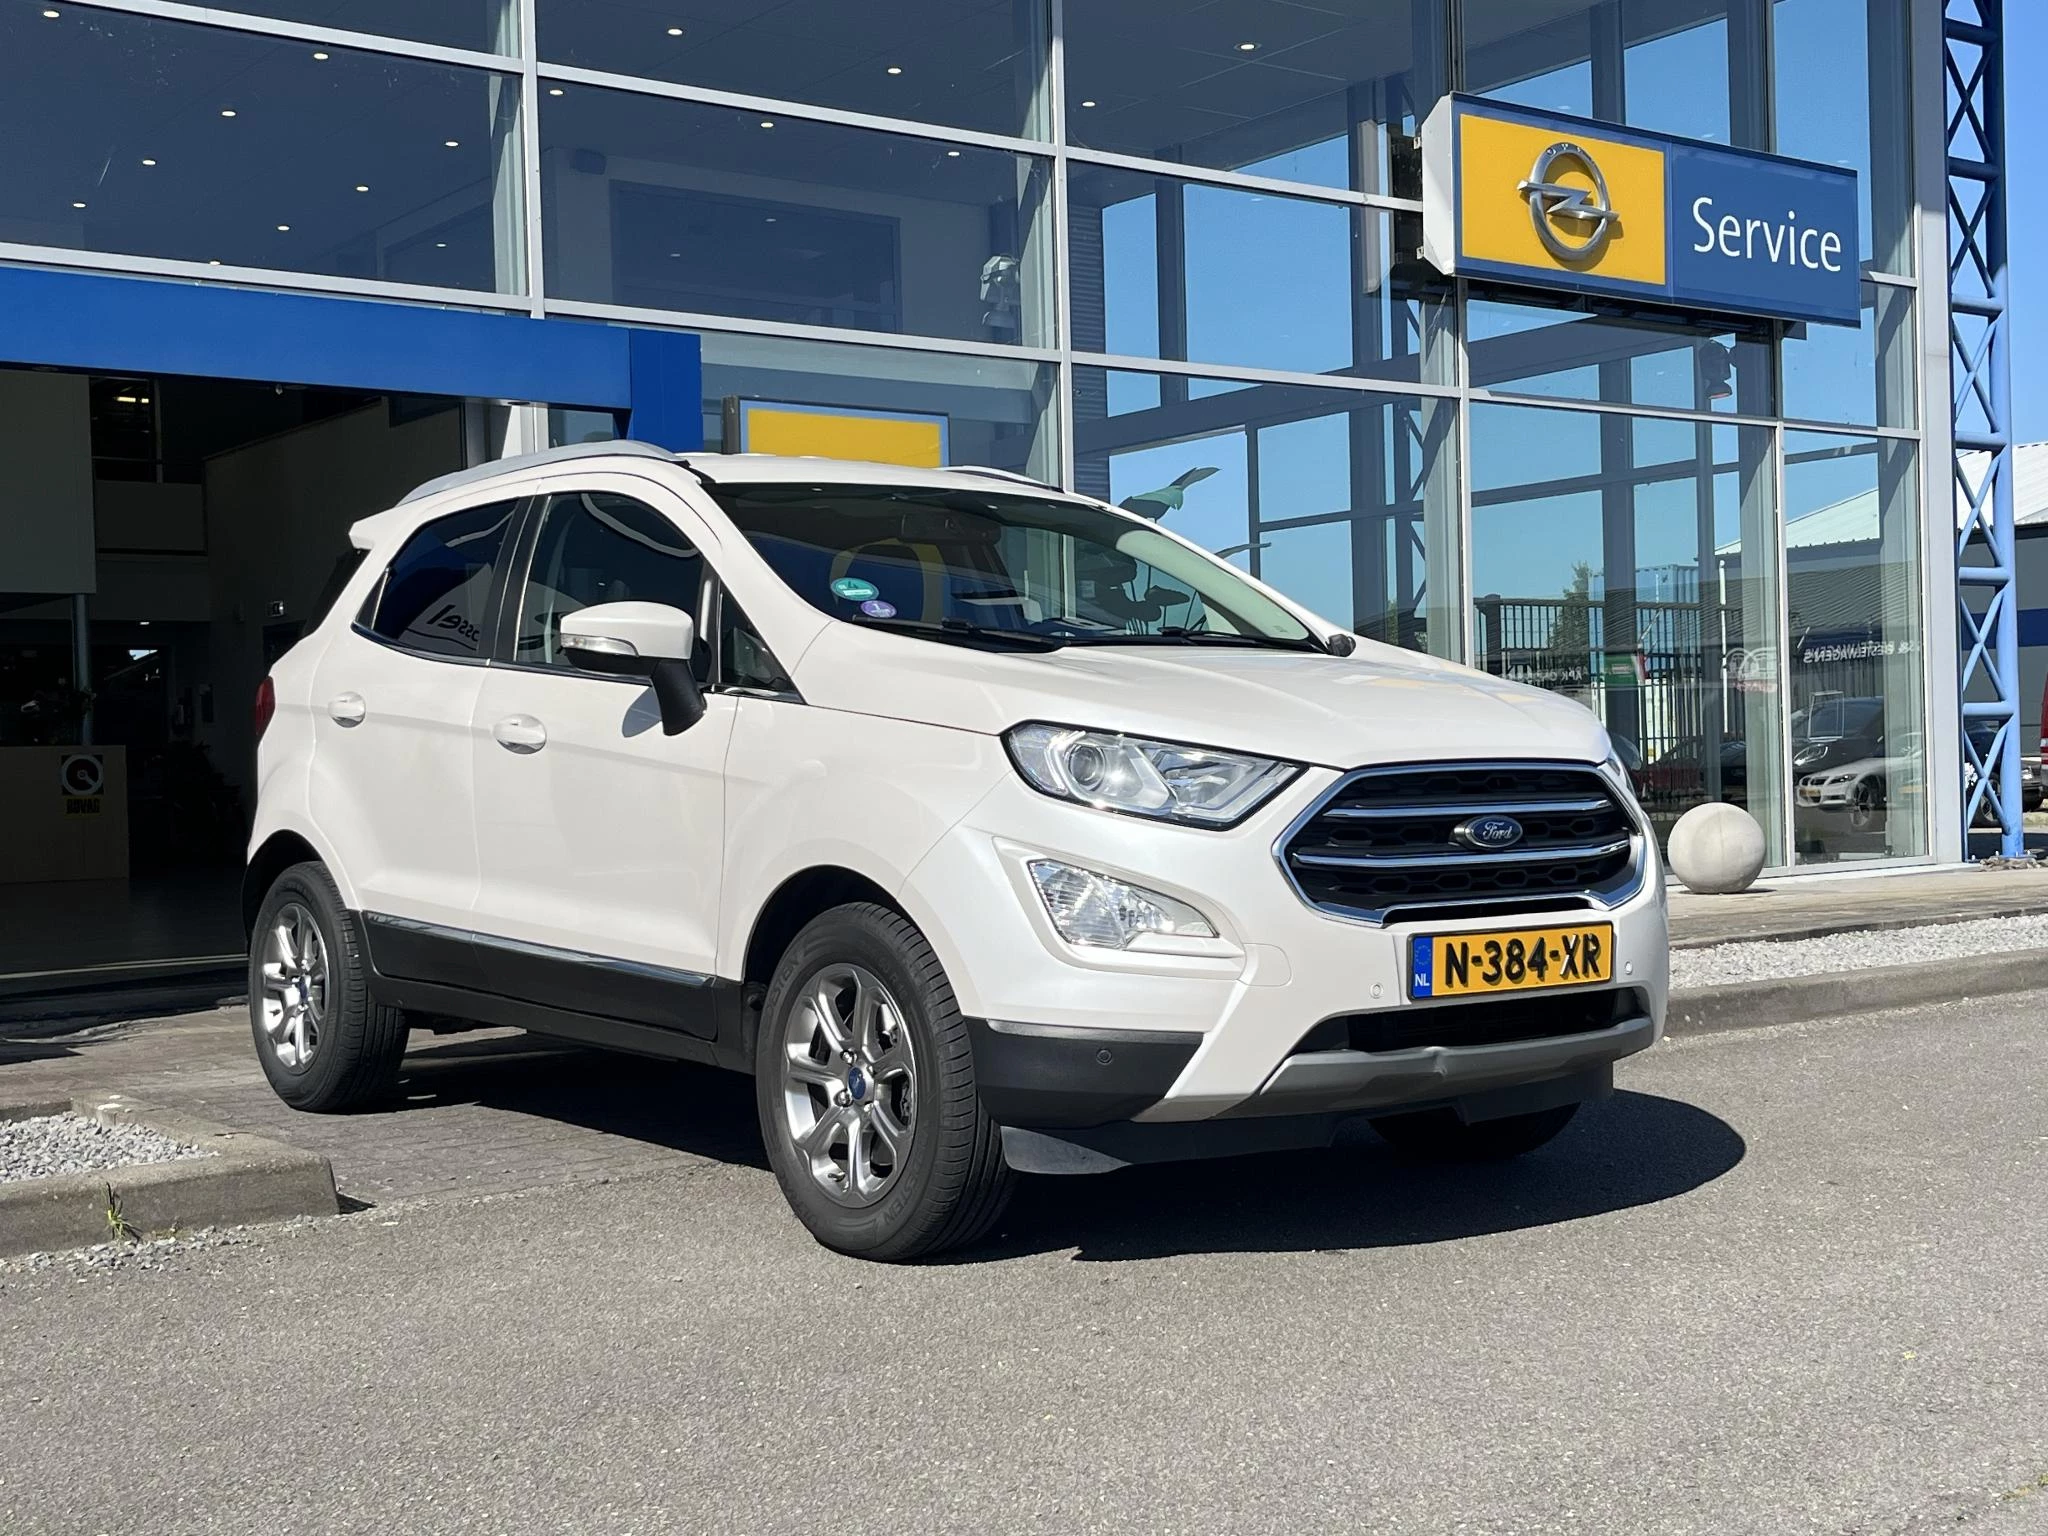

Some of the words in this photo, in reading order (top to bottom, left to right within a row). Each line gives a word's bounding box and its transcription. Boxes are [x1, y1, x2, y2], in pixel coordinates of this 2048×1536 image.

[1693, 197, 1841, 272] Service
[1482, 821, 1513, 840] Ford
[1445, 933, 1602, 988] N-384-XR
[1414, 973, 1430, 987] NL
